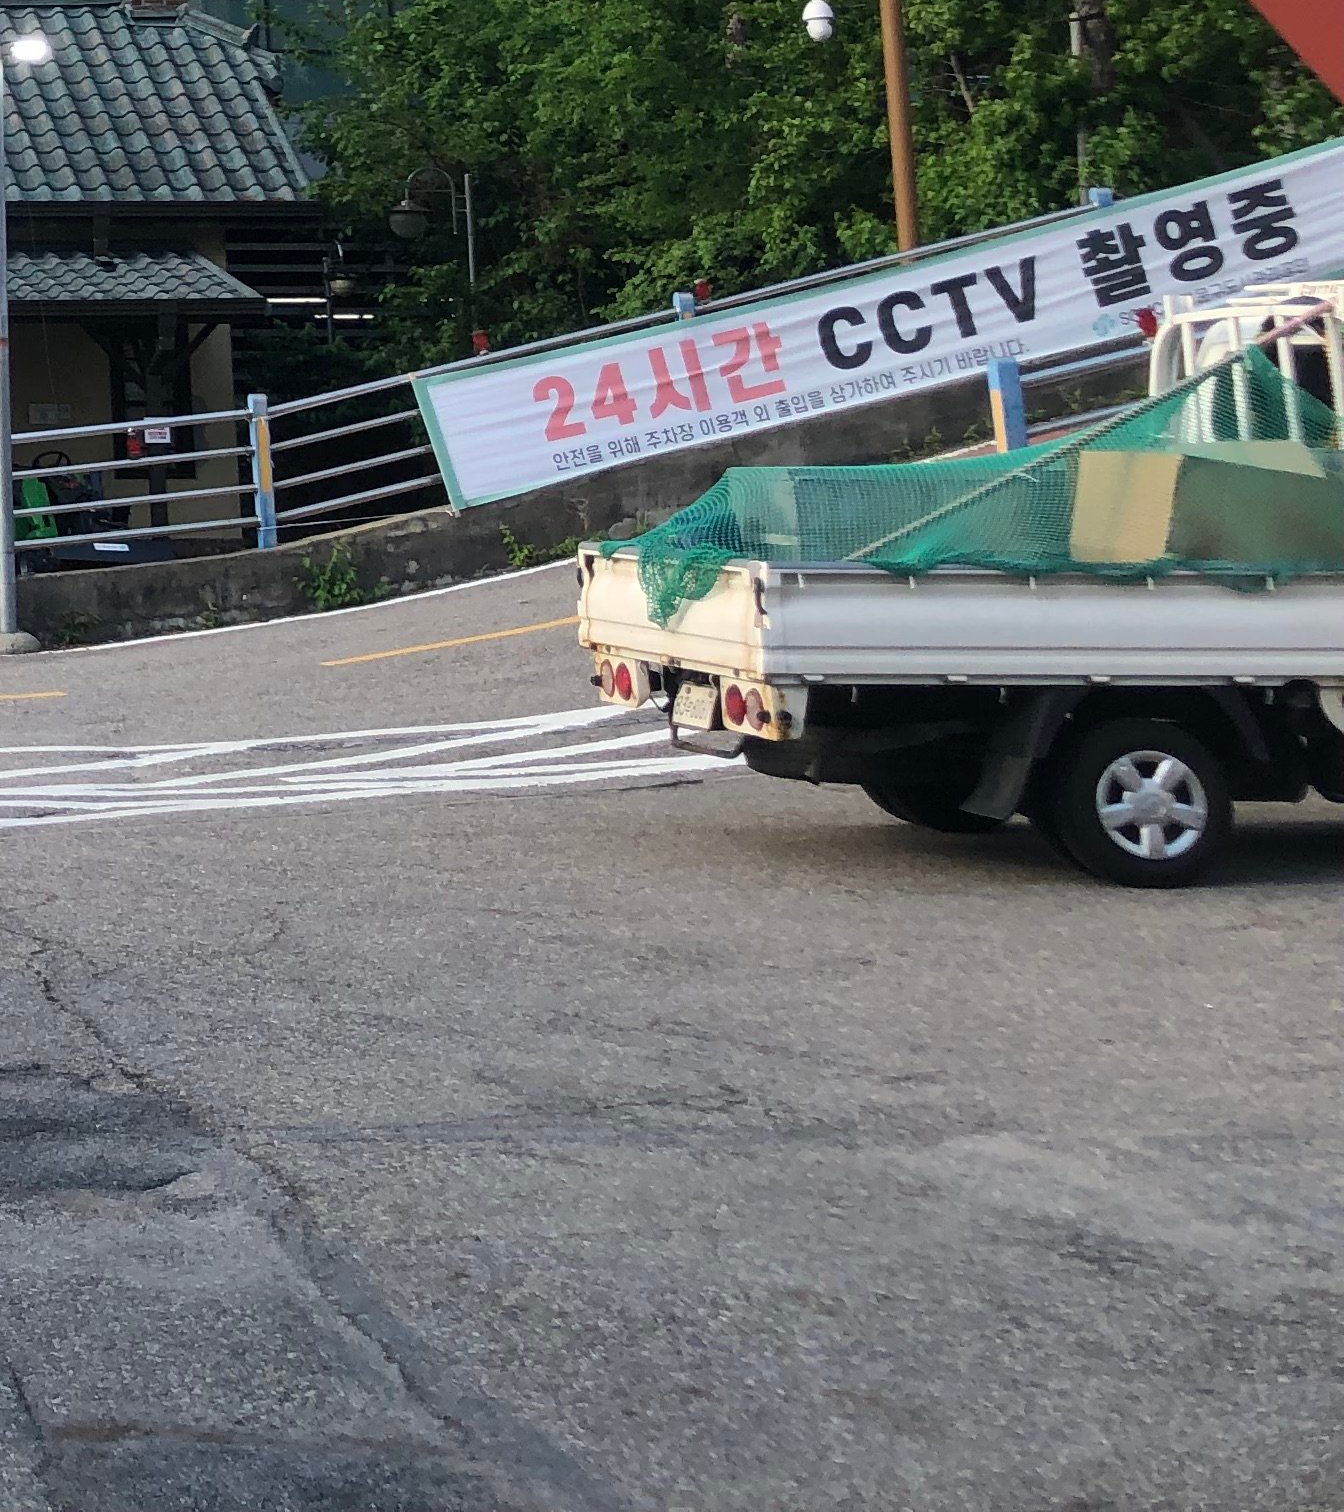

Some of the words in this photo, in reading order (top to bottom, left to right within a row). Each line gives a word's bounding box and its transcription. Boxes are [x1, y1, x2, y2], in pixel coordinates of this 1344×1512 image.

[531, 320, 786, 442] 24시간
[815, 254, 1038, 371] CCTV
[1076, 178, 1300, 308] 촬영중
[551, 441, 606, 472] 안전을
[608, 434, 642, 459] 위해
[645, 423, 696, 450] 주차장
[699, 409, 750, 438] 이용객
[774, 389, 828, 419] 출입을
[828, 371, 897, 406] 삼가하여
[899, 359, 952, 387] 주시기
